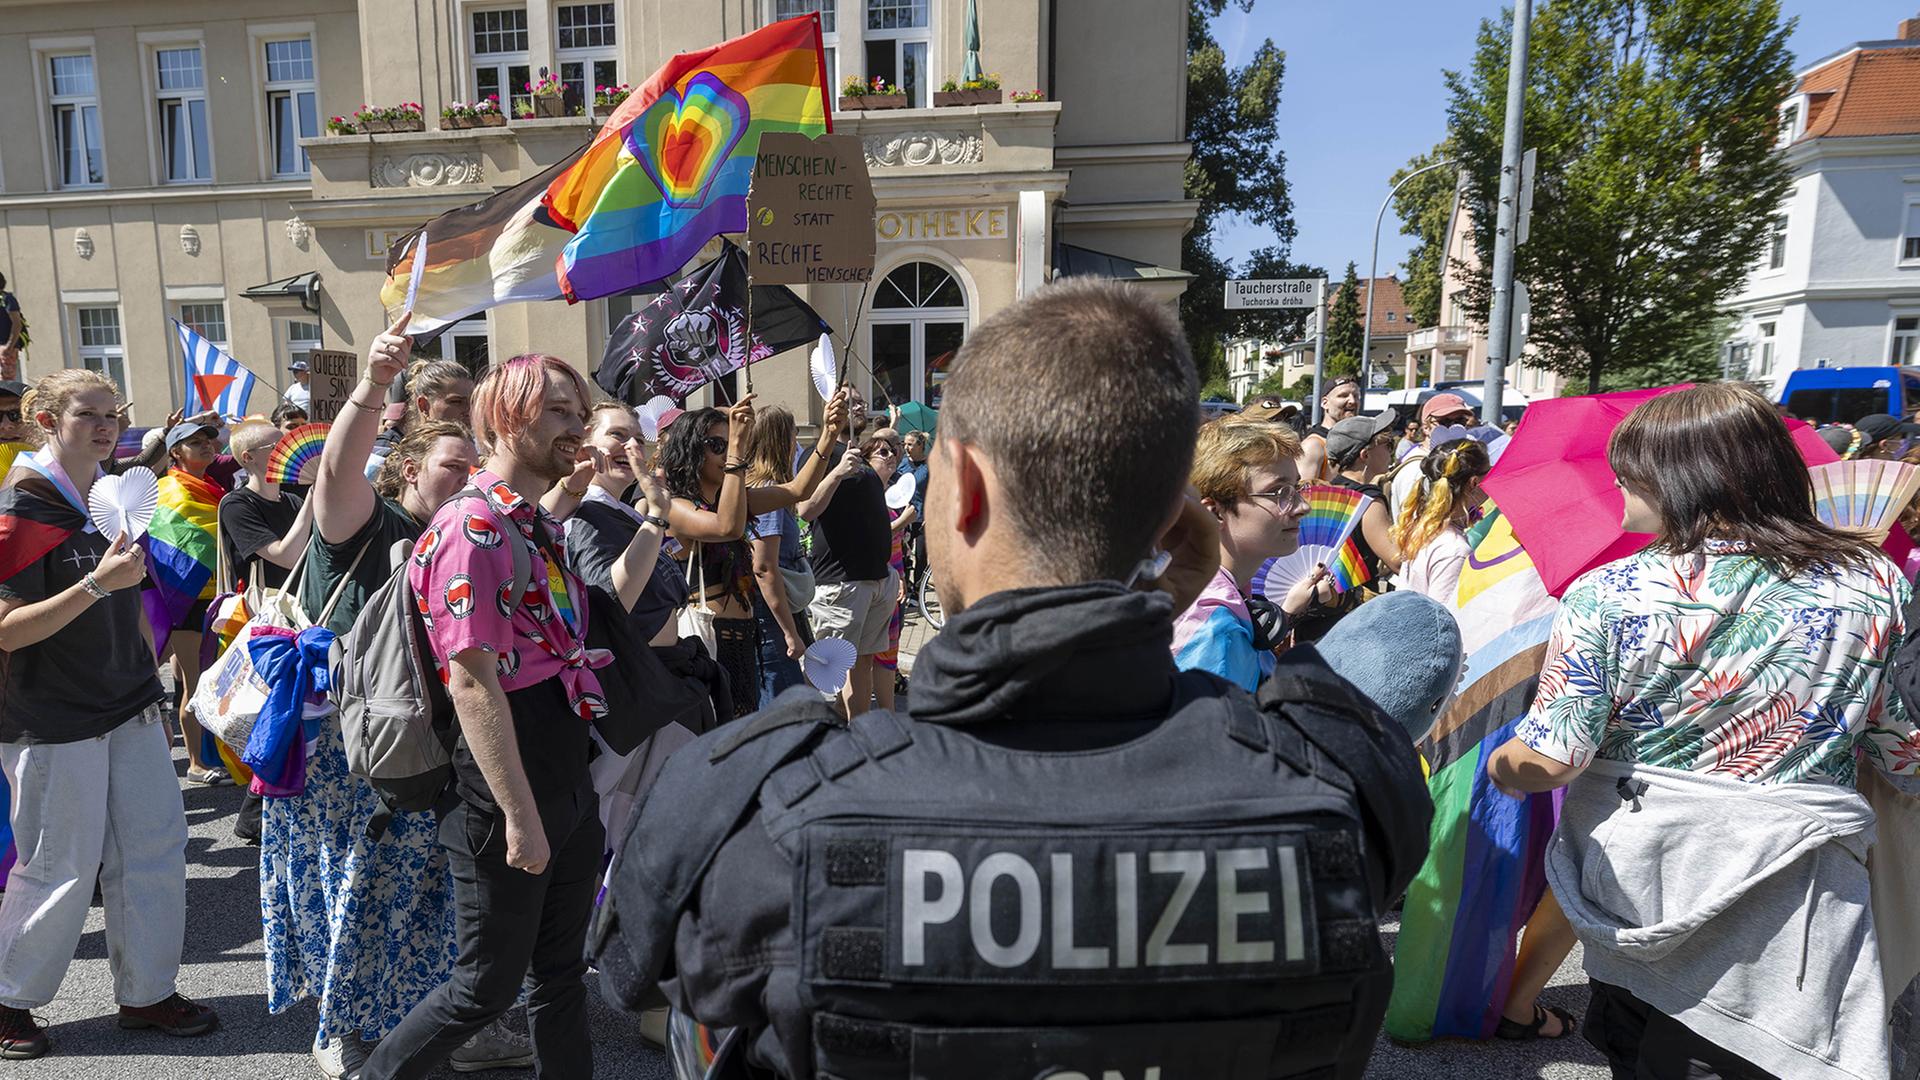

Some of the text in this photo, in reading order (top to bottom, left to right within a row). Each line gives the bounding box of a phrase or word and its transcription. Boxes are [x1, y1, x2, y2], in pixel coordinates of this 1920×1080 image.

[799, 183, 853, 200] RECHTE
[793, 213, 834, 226] STATT
[878, 209, 1005, 240] OTHEKE
[757, 242, 822, 265] RECHTE
[1235, 281, 1312, 294] Taucherstraße
[1242, 297, 1279, 306] Tuchorska
[903, 846, 1305, 969] POLIZEI
